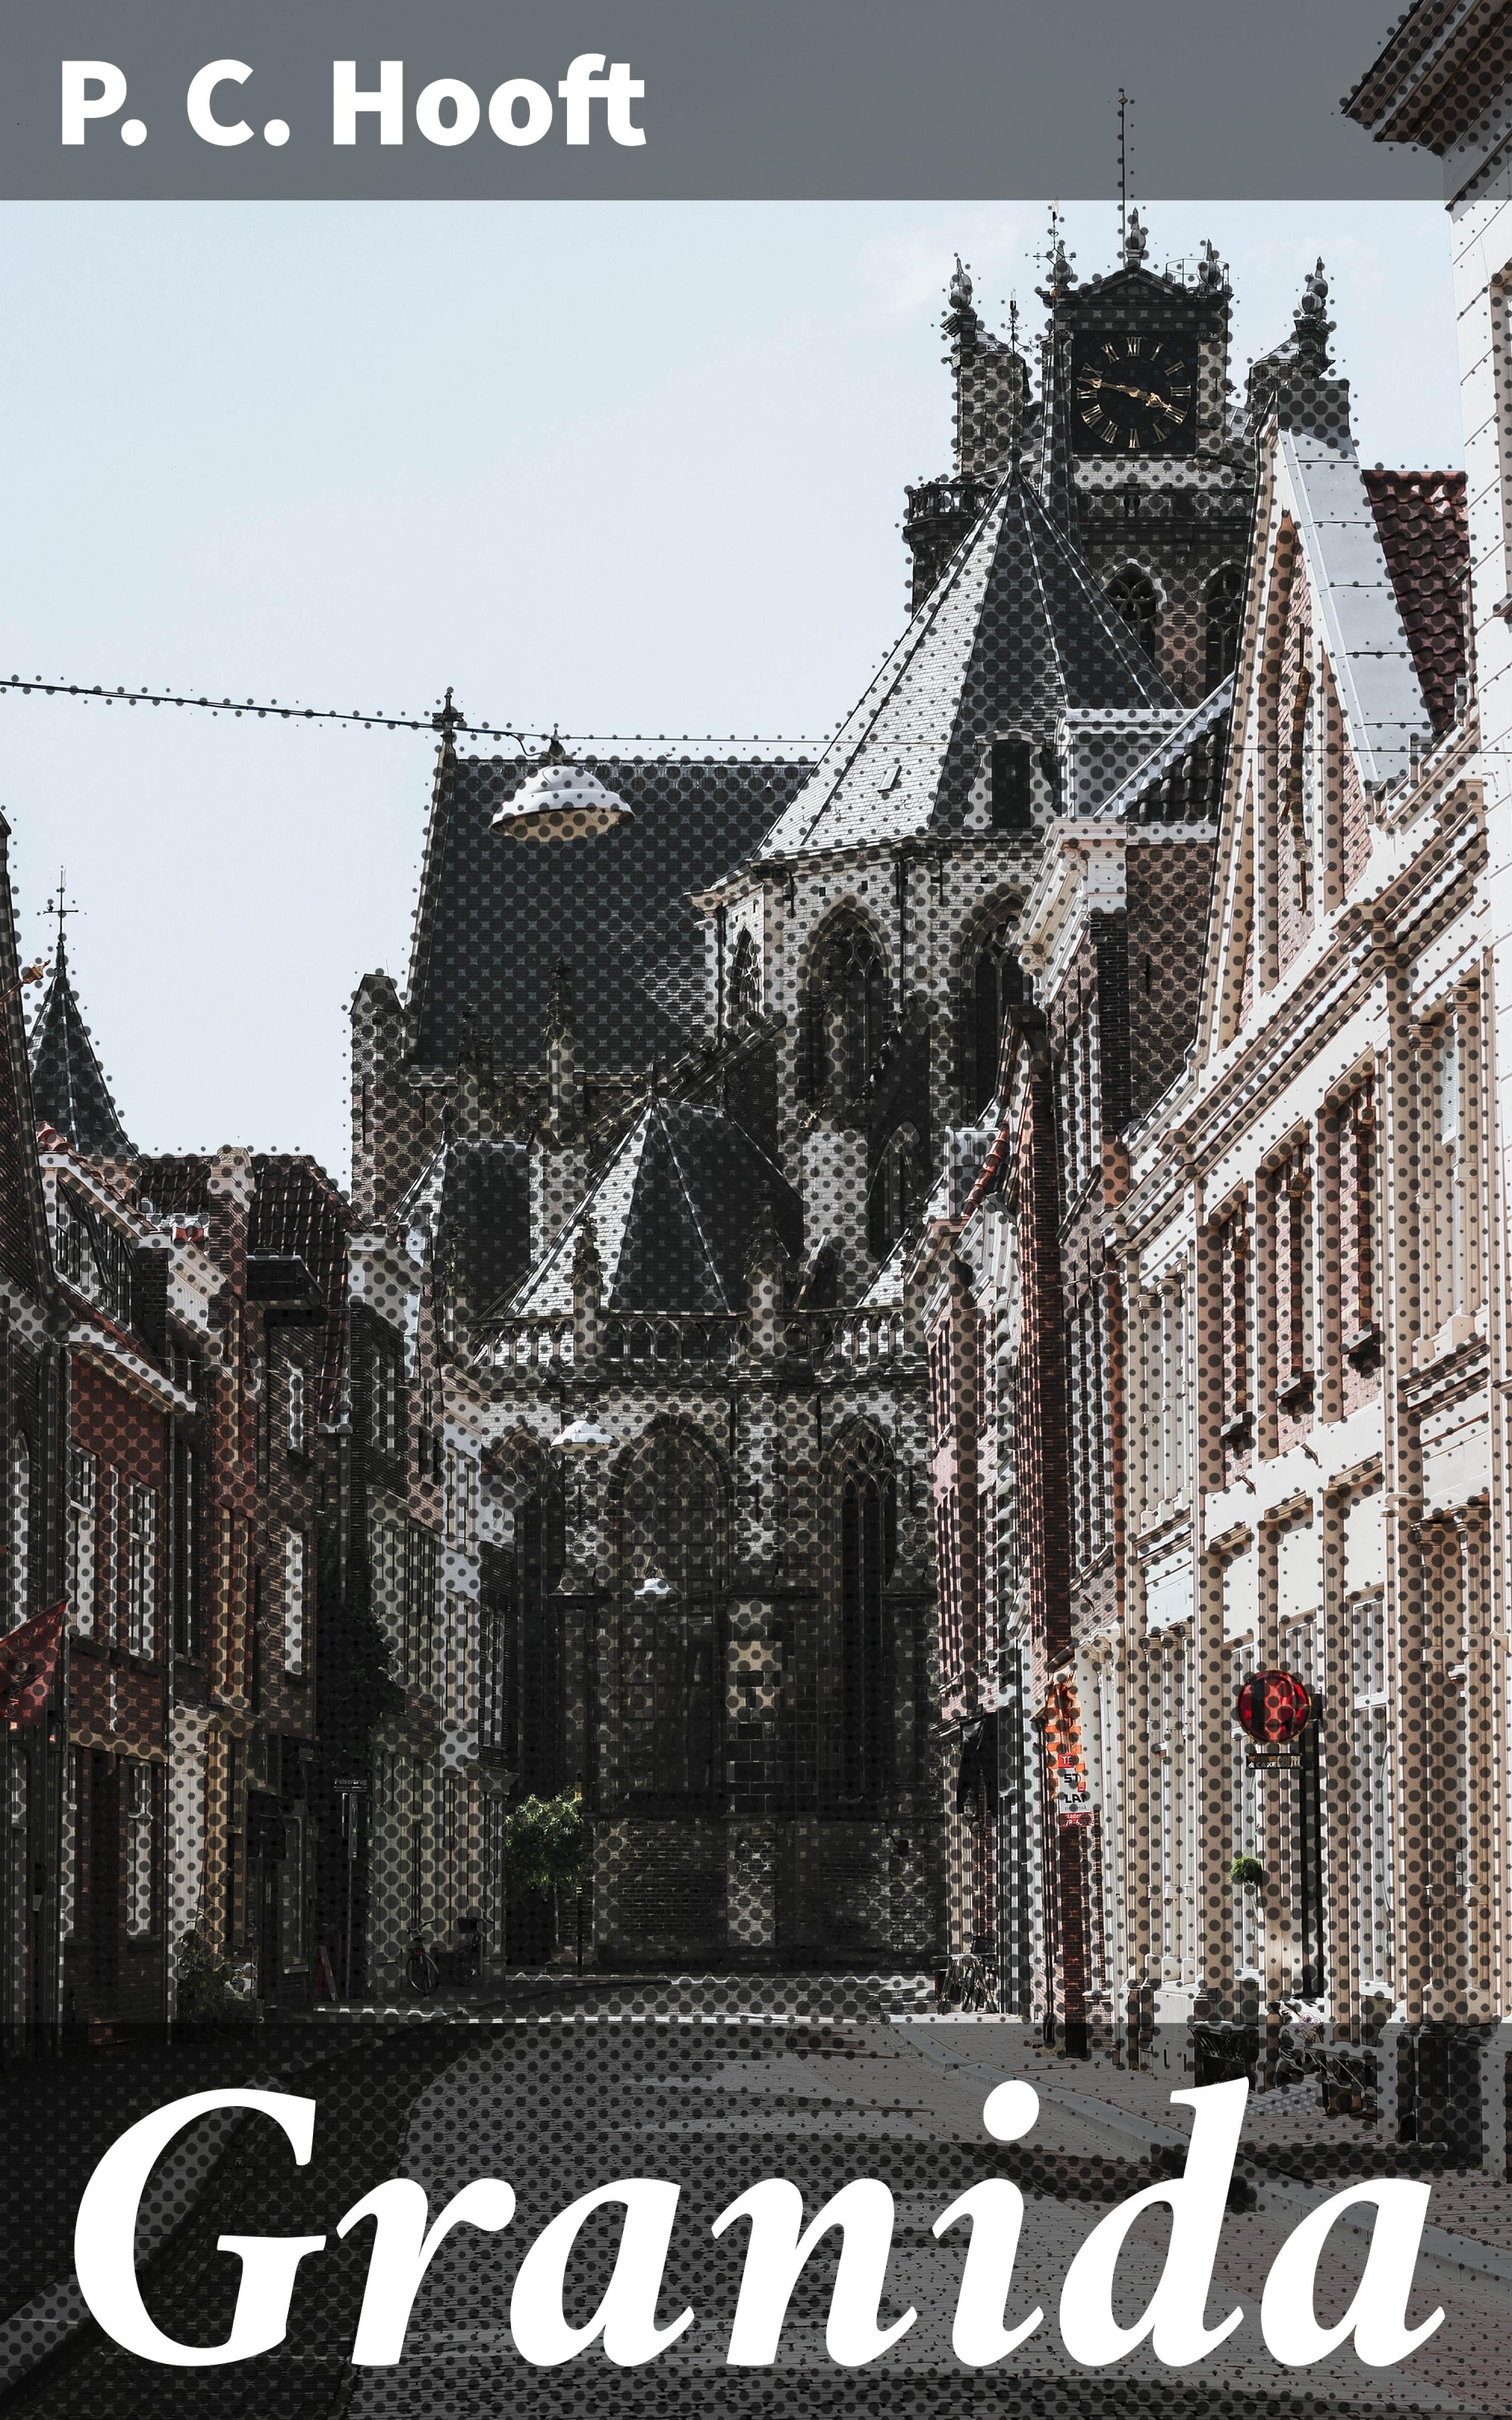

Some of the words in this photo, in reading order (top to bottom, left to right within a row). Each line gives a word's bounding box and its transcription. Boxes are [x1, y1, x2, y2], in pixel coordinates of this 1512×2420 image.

[1125, 337, 1142, 357] XII
[1150, 342, 1163, 361] I
[1164, 360, 1185, 377] II
[1170, 385, 1191, 397] III
[4, 1651, 31, 1719] KAPSALON
